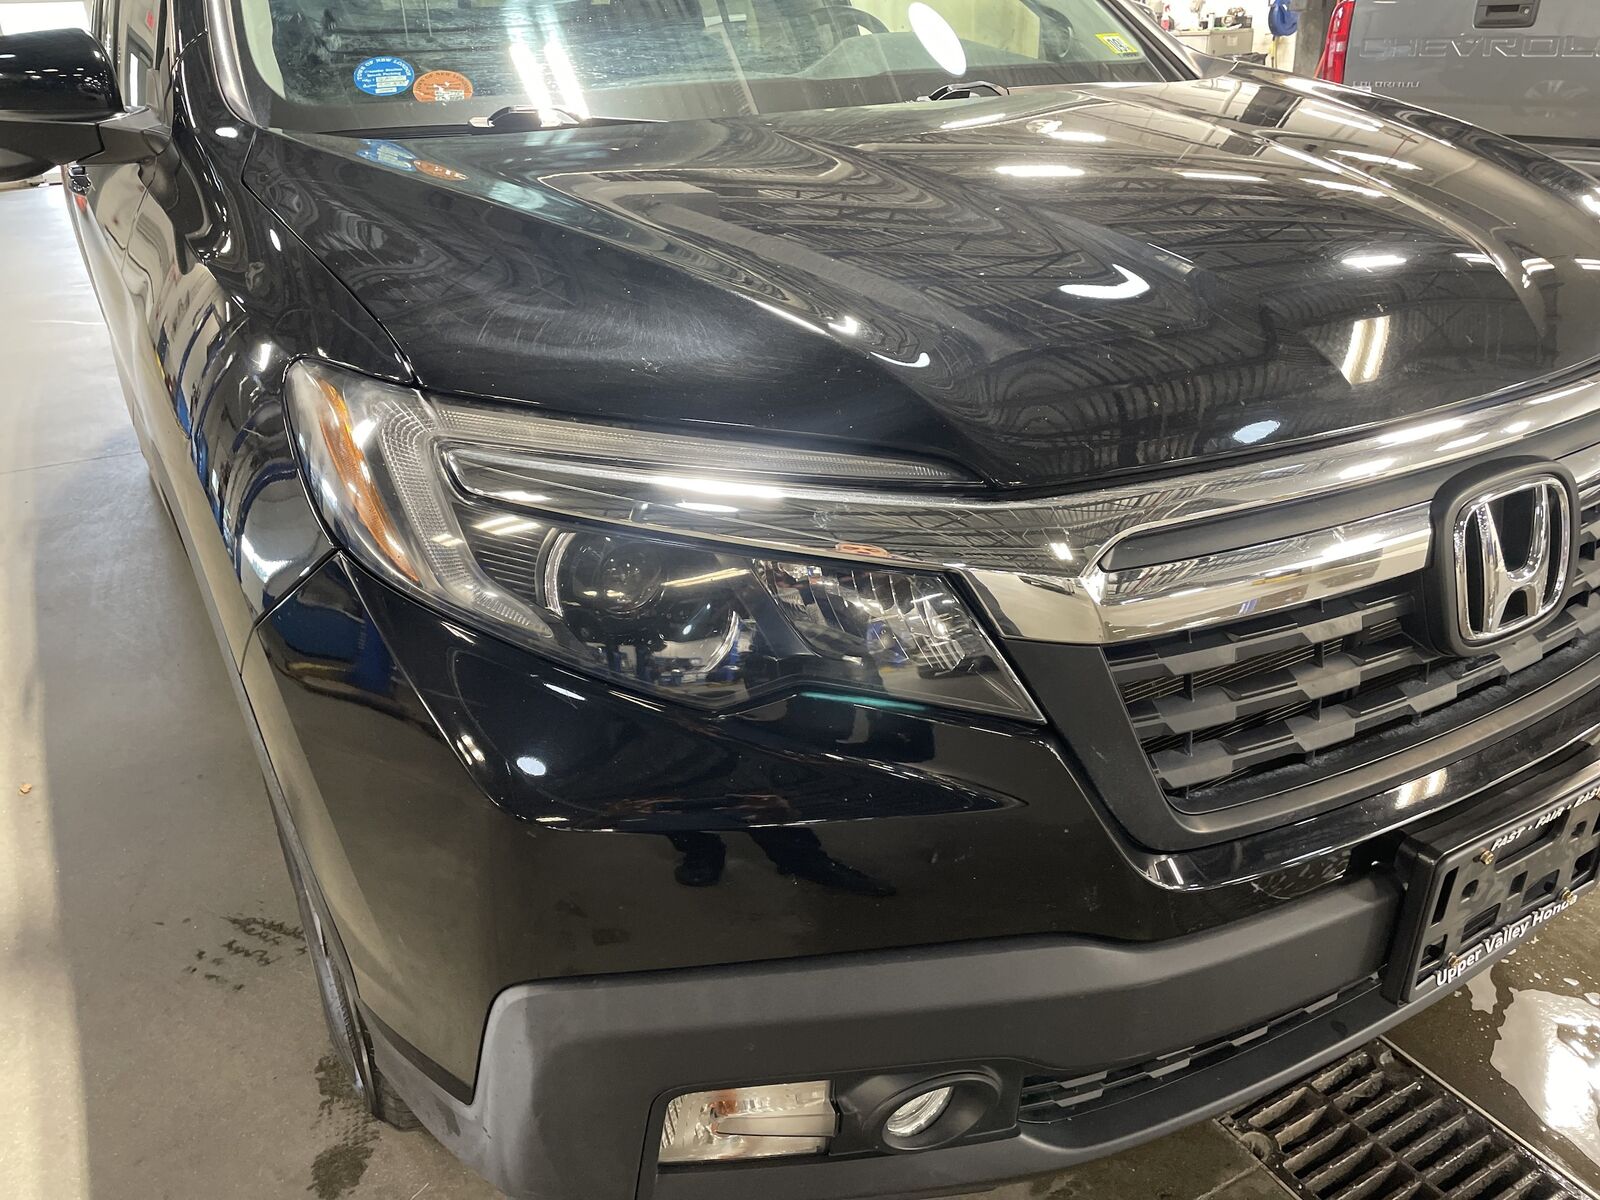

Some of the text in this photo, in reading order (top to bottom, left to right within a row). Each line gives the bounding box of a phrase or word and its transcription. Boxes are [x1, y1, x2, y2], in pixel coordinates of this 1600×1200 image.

[1359, 36, 1600, 58] CHEVROL
[1491, 826, 1526, 851] FAST
[1535, 806, 1564, 829] FAIR
[1436, 950, 1481, 986] Upper
[1484, 920, 1530, 953] Valley
